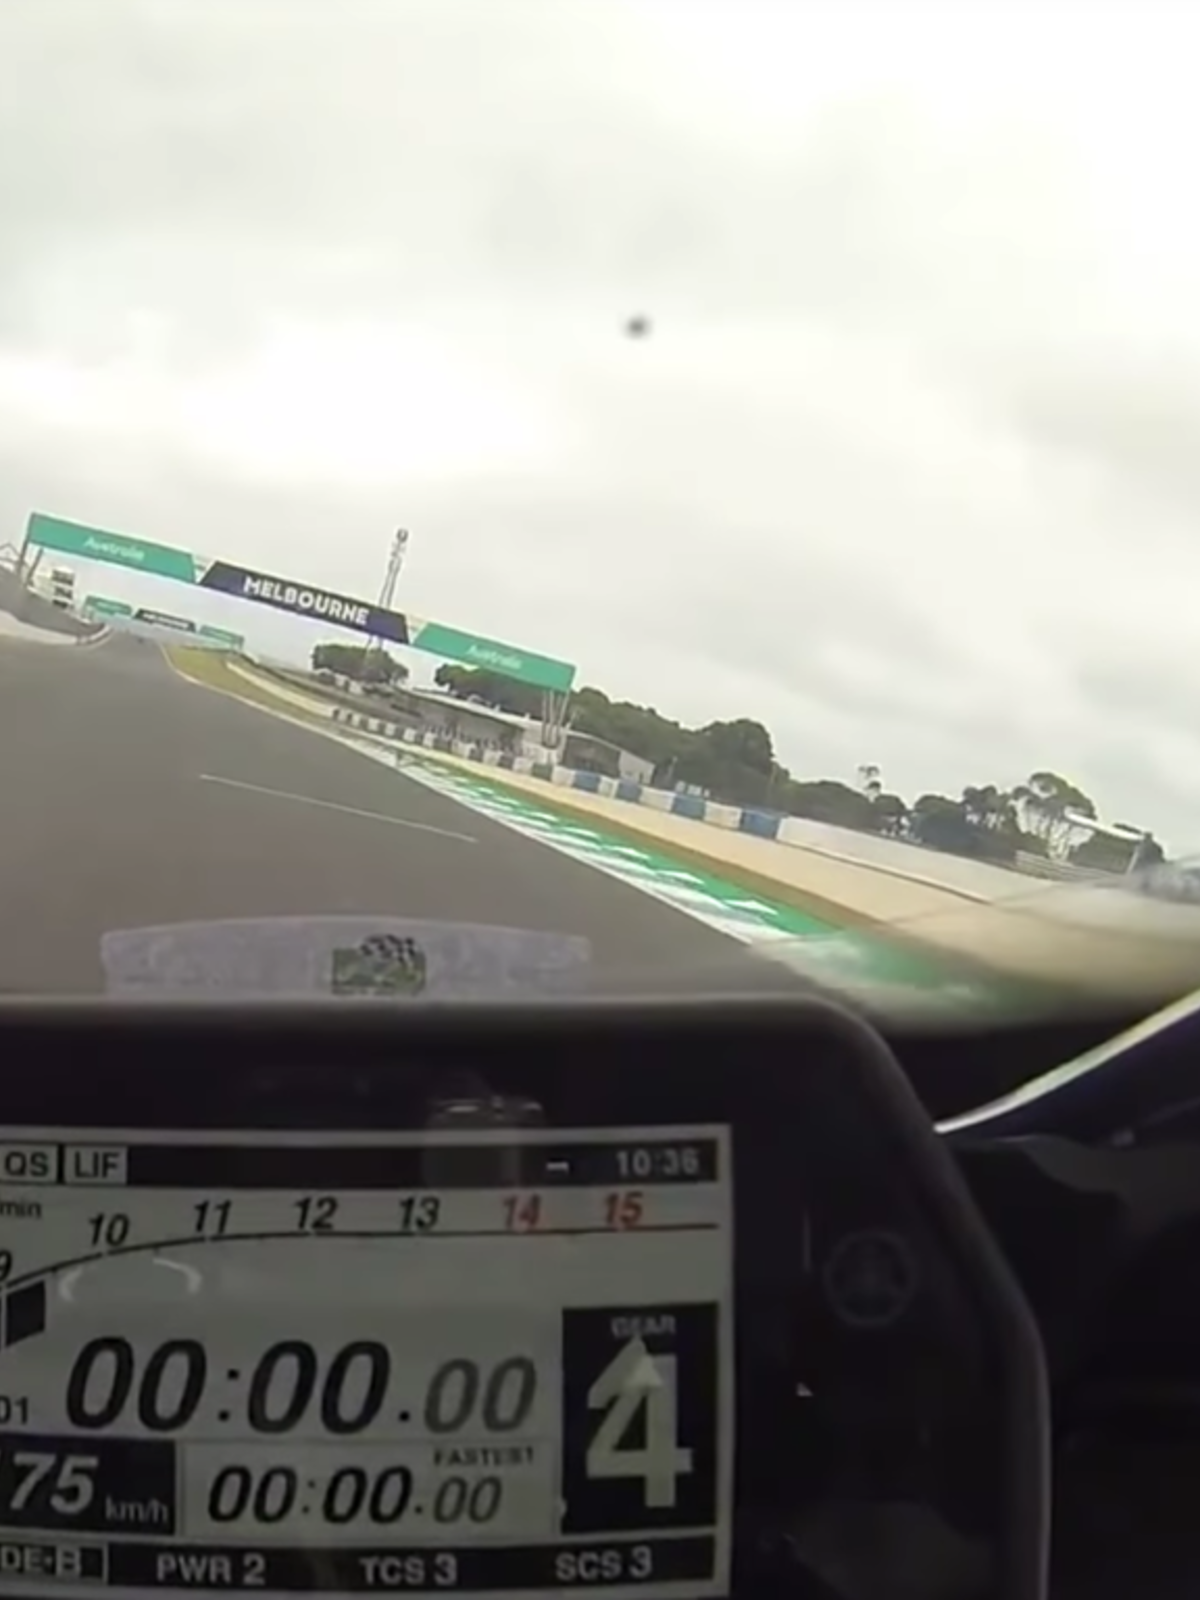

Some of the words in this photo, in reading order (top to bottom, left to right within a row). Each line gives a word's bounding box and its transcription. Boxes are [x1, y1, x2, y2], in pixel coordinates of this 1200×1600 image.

[243, 575, 370, 626] MELBOURNE
[4, 1151, 50, 1178] QS
[74, 1151, 121, 1179] LIF
[194, 1200, 233, 1235] 11
[294, 1196, 338, 1231] 12
[400, 1196, 441, 1230] 13
[503, 1195, 543, 1230] 14
[605, 1192, 645, 1228] 15
[89, 1213, 130, 1247] 10
[610, 1314, 677, 1338] GEAR
[586, 1353, 693, 1508] 4
[105, 1495, 169, 1524] km/h
[156, 1554, 232, 1584] PWR
[242, 1554, 266, 1585] 2
[359, 1555, 426, 1585] TCS
[433, 1553, 459, 1586] 3
[554, 1553, 623, 1581] SCS
[630, 1546, 653, 1579] 3
